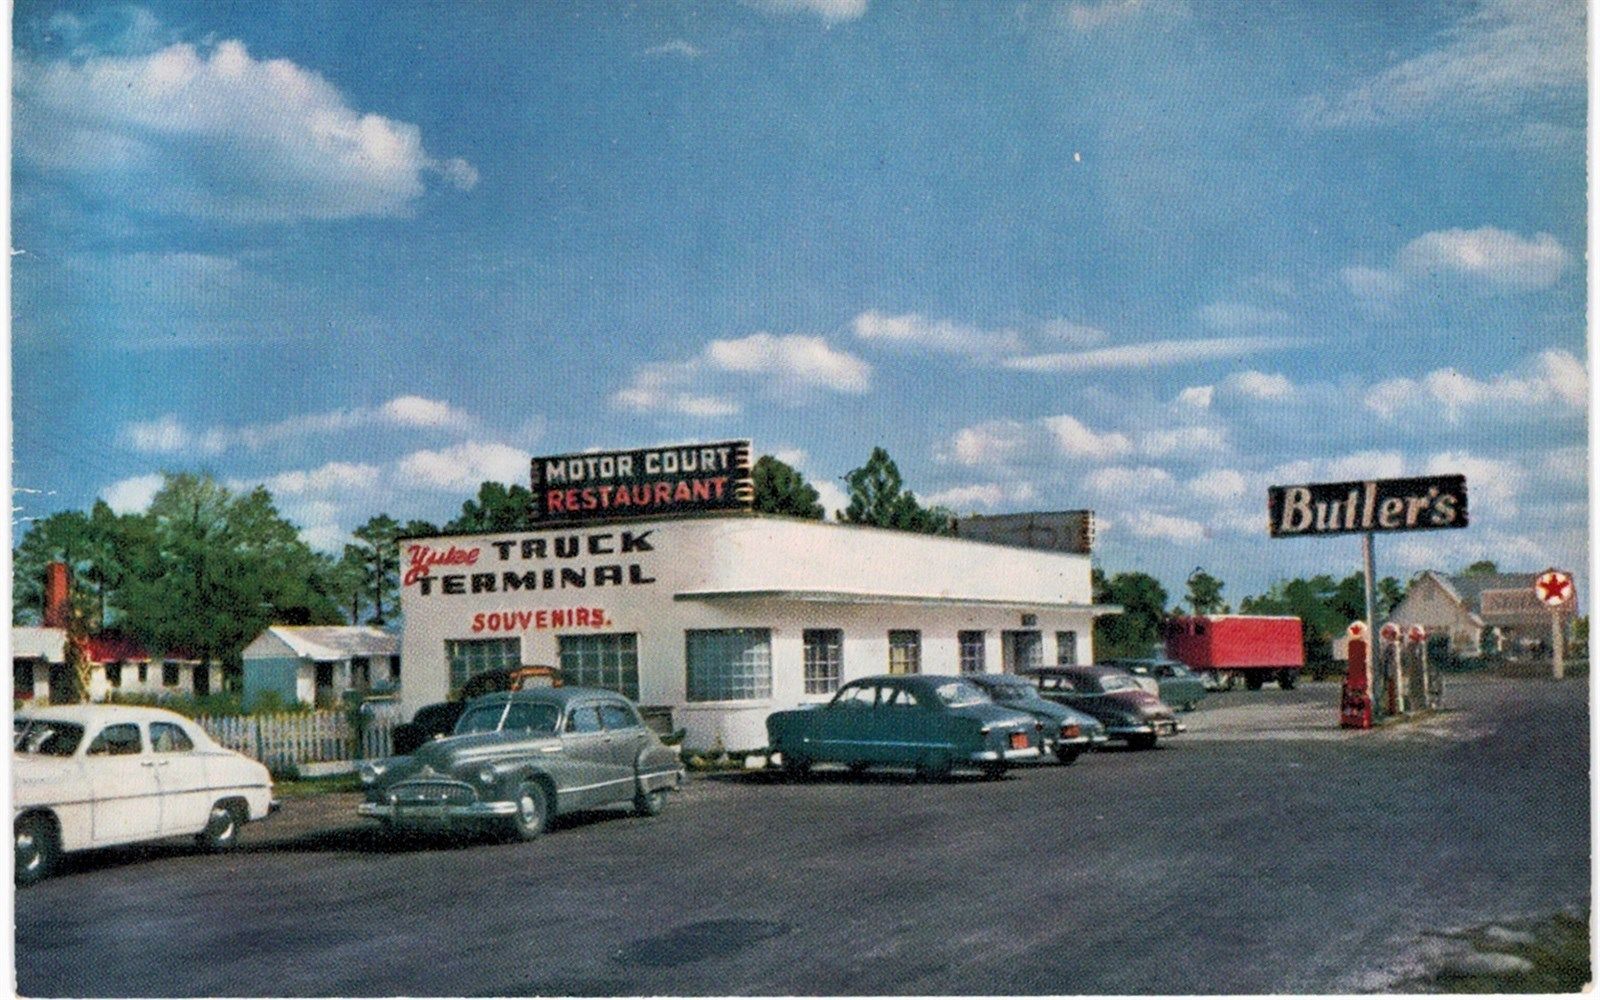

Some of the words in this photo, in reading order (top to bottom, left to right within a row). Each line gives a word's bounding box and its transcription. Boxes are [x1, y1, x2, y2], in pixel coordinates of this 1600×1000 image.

[546, 455, 633, 482] MOTOR
[645, 446, 732, 474] COURT
[547, 477, 728, 512] RESTAURANT
[1281, 481, 1458, 532] Butler's
[492, 529, 655, 561] TRUCK
[418, 564, 656, 595] TERMINAL
